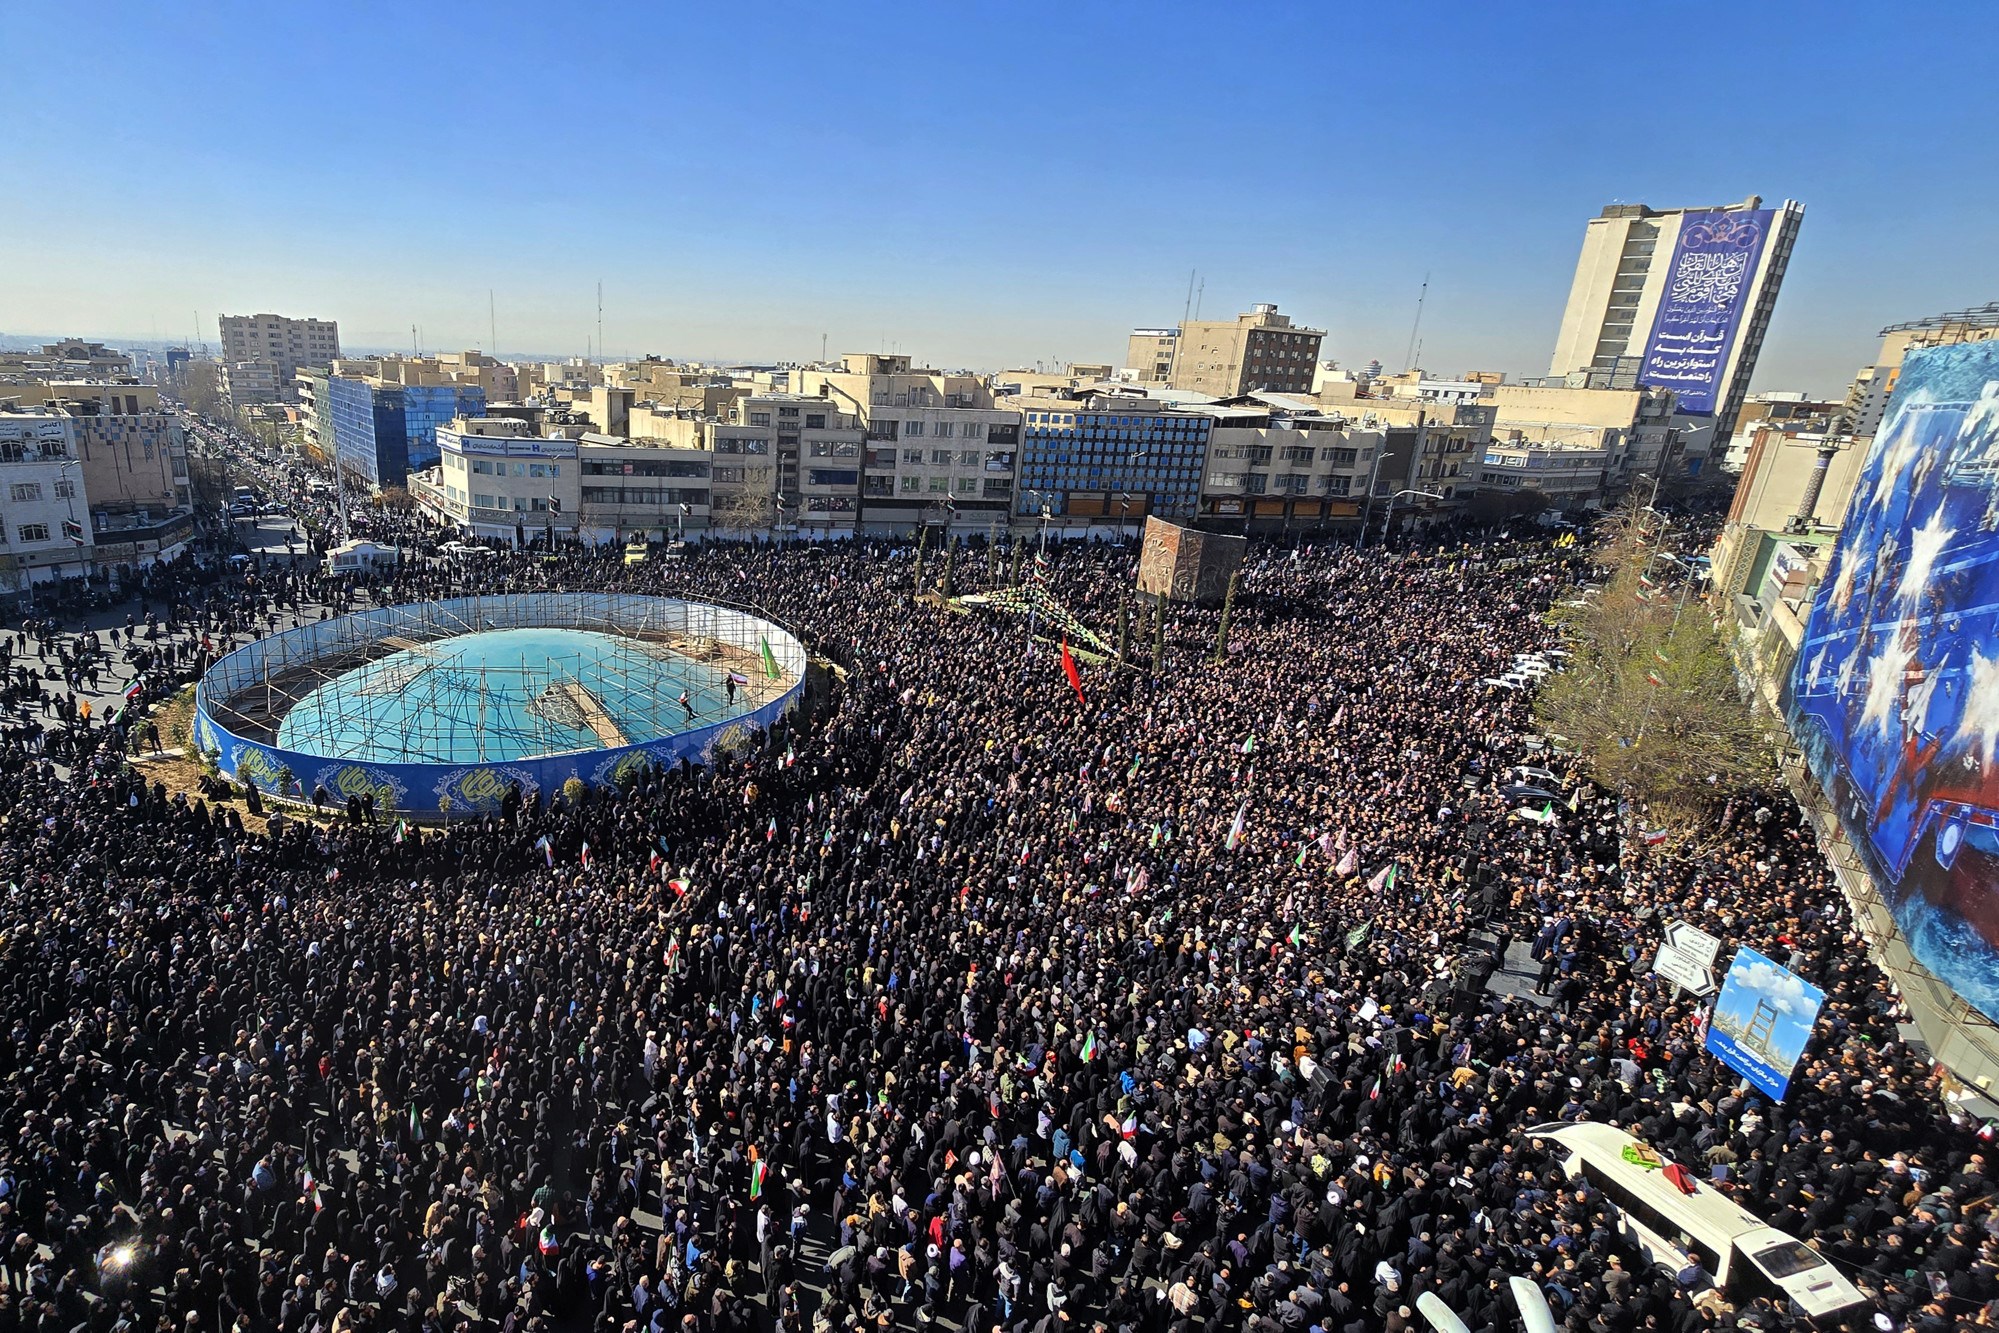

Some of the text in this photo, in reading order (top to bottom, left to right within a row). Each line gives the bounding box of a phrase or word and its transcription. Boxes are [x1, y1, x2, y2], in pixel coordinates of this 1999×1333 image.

[1658, 330, 1724, 343] قرآن است
[1654, 343, 1722, 355] که به
[1651, 356, 1716, 369] استوارترین راه
